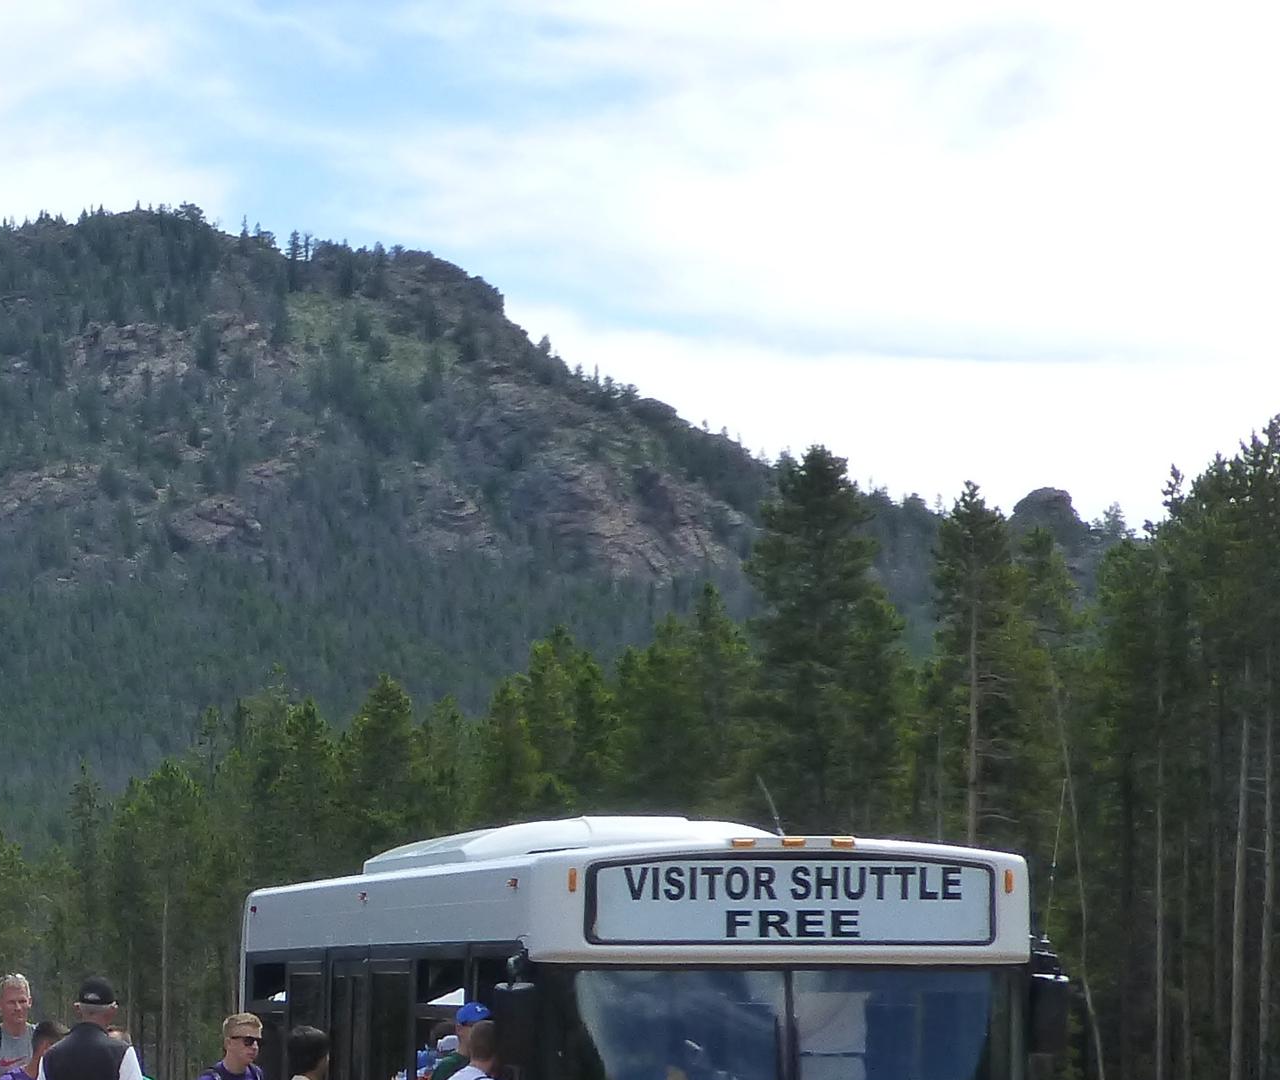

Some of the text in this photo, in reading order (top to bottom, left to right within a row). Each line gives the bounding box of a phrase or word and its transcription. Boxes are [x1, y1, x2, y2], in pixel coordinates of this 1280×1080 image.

[623, 866, 963, 901] VISITOR SHUTTLE
[725, 909, 861, 938] FREE
